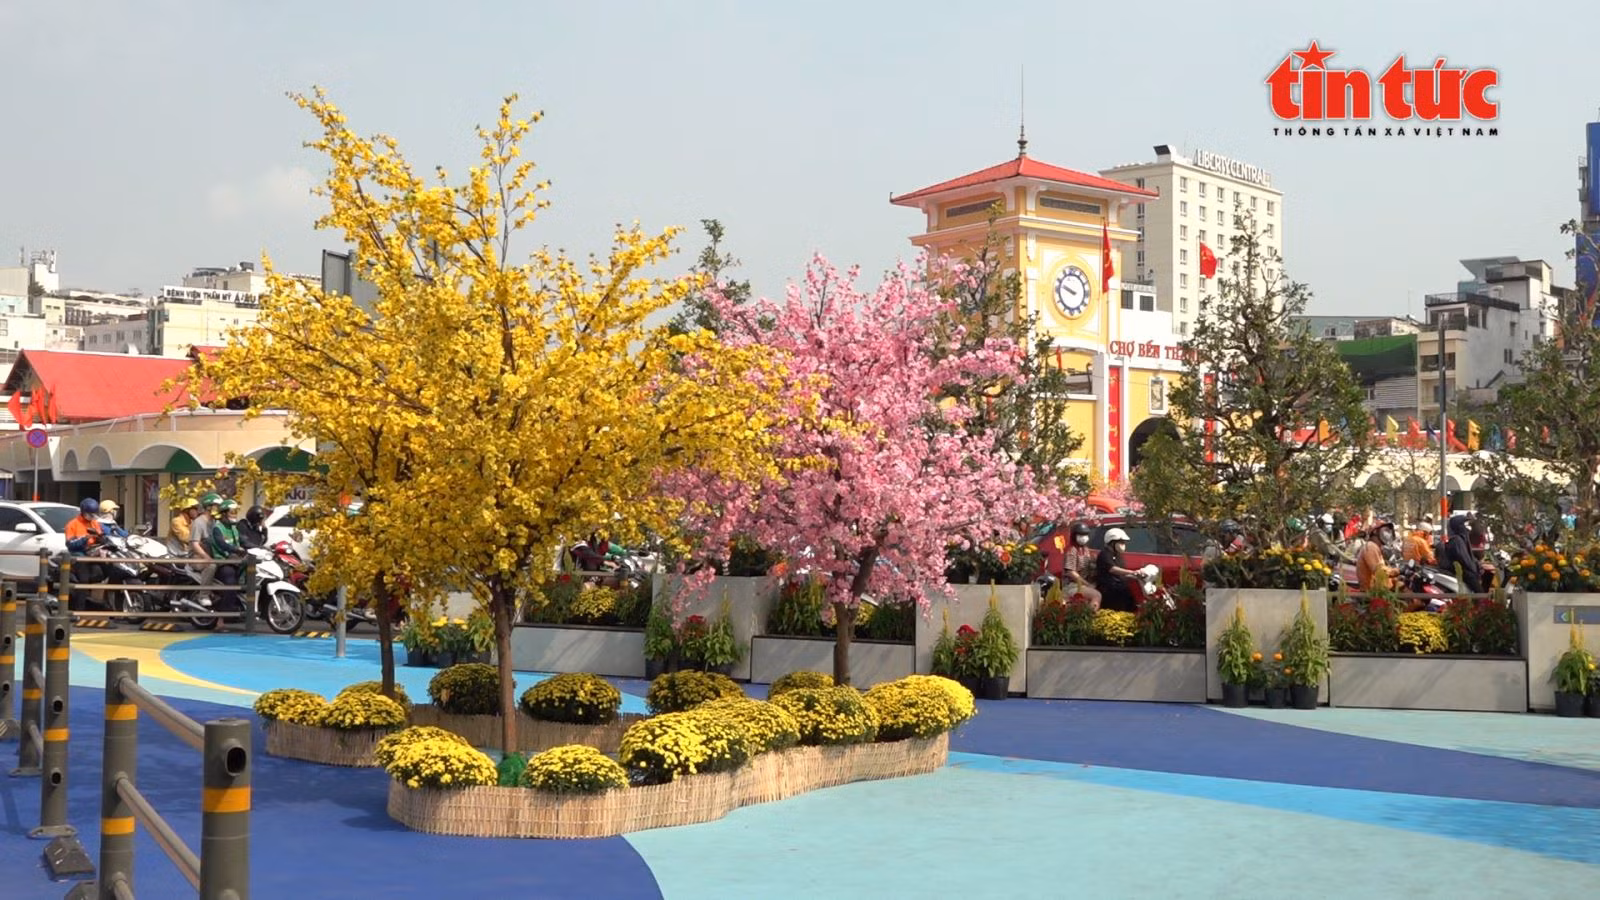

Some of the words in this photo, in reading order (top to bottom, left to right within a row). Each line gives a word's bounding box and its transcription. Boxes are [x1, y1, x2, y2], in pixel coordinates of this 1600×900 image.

[1196, 148, 1231, 175] LIBERTY
[1231, 159, 1268, 186] CENTRAL
[1109, 340, 1135, 359] CHỢ
[1138, 339, 1160, 359] BẾN
